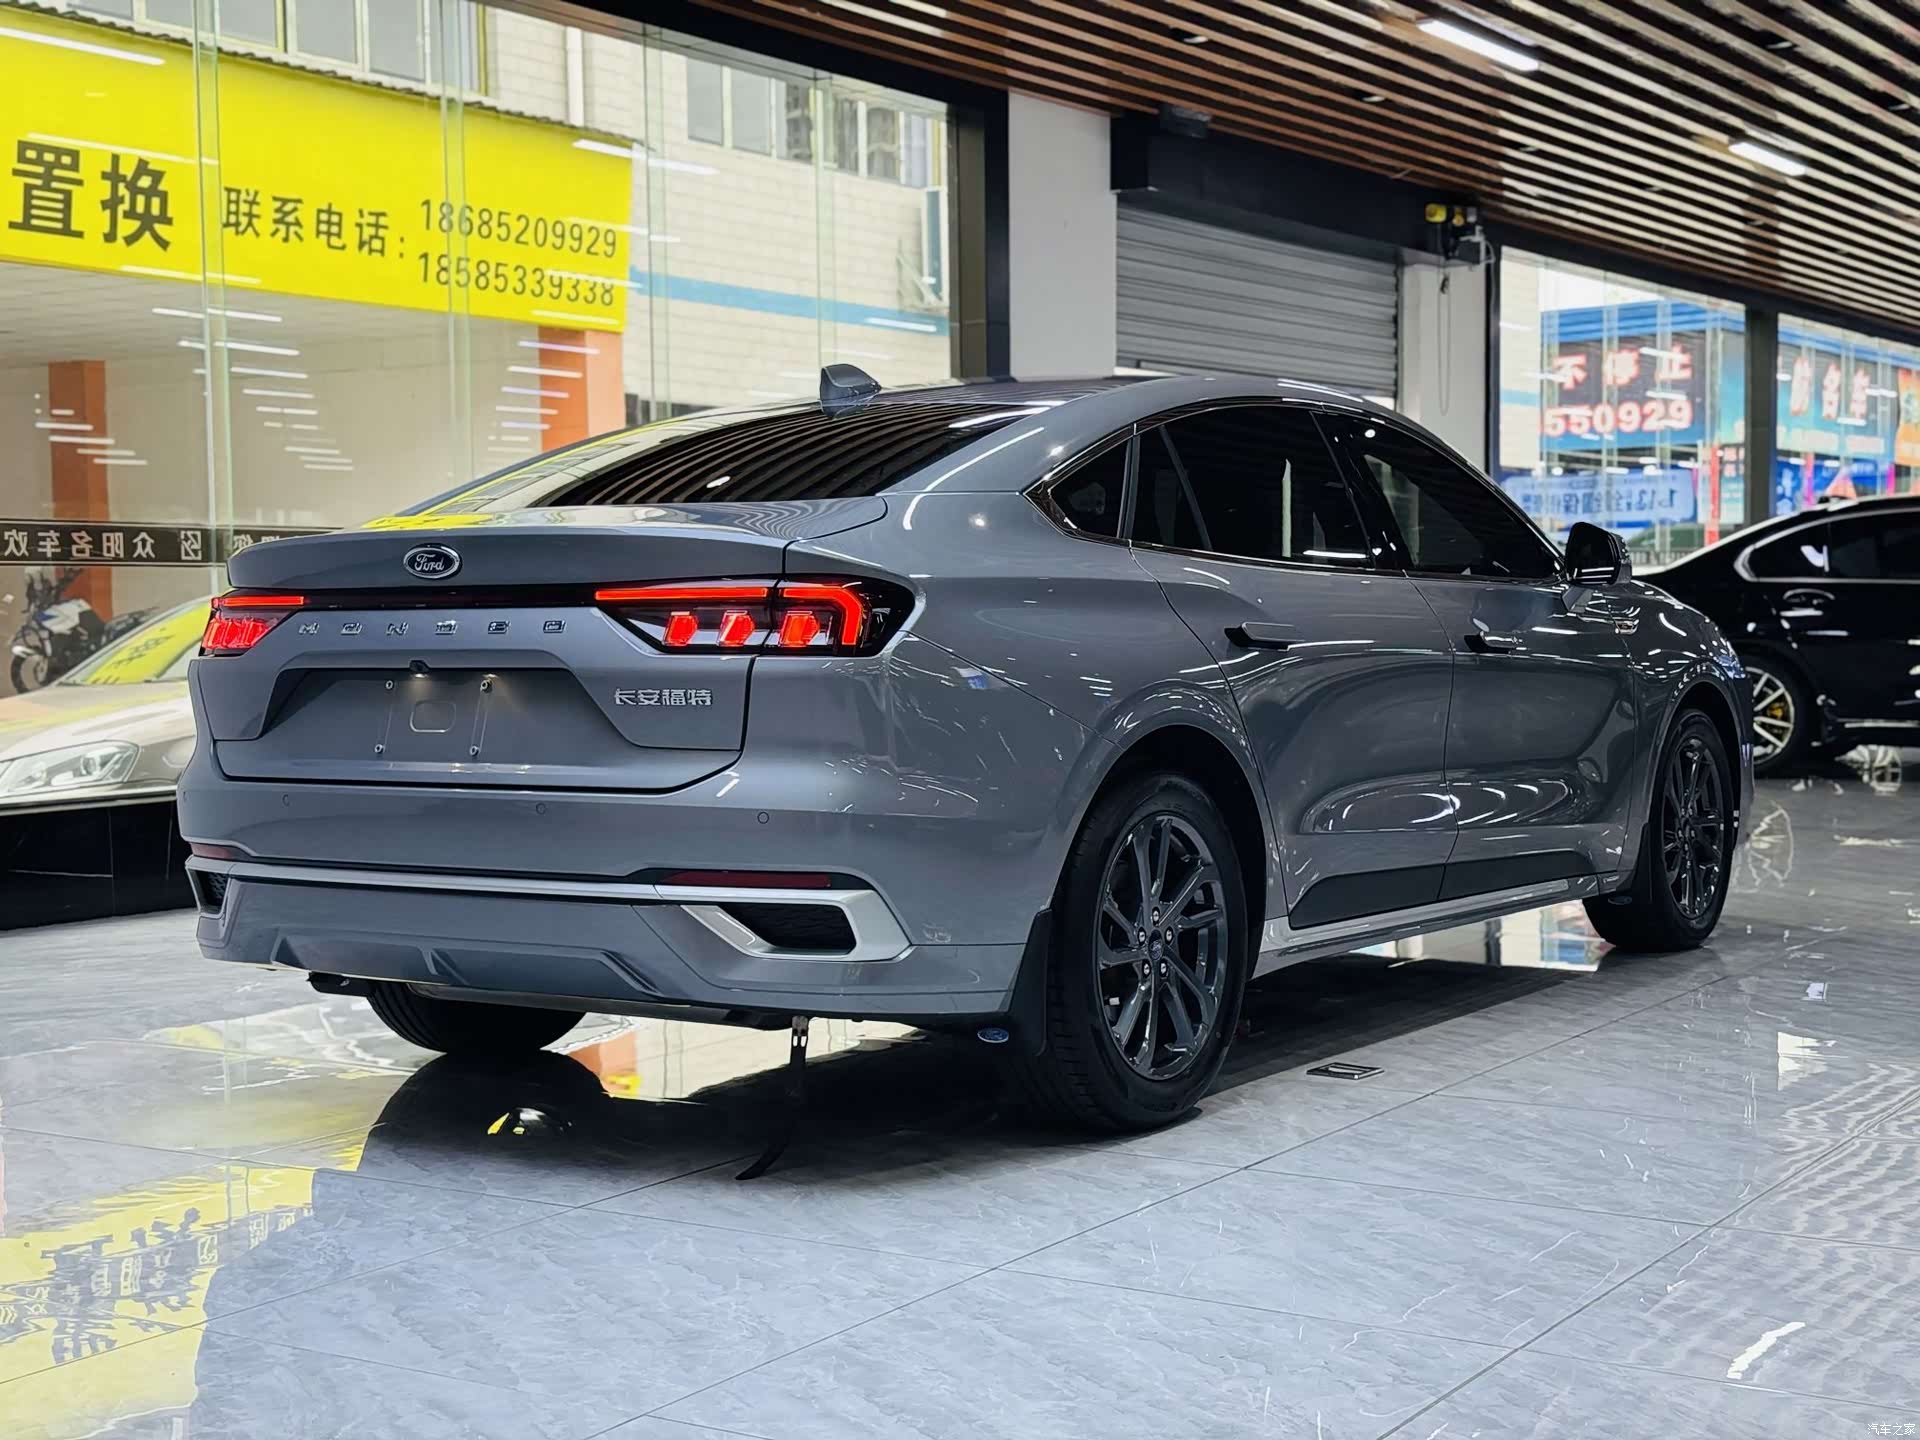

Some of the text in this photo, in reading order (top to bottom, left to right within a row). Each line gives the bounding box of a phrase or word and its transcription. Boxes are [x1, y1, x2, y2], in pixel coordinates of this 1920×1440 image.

[8, 139, 174, 252] 置换
[420, 198, 618, 259] 18685209929
[417, 251, 615, 307] 18585339338
[298, 619, 567, 636] MONDEO
[613, 687, 712, 707] 长安福特
